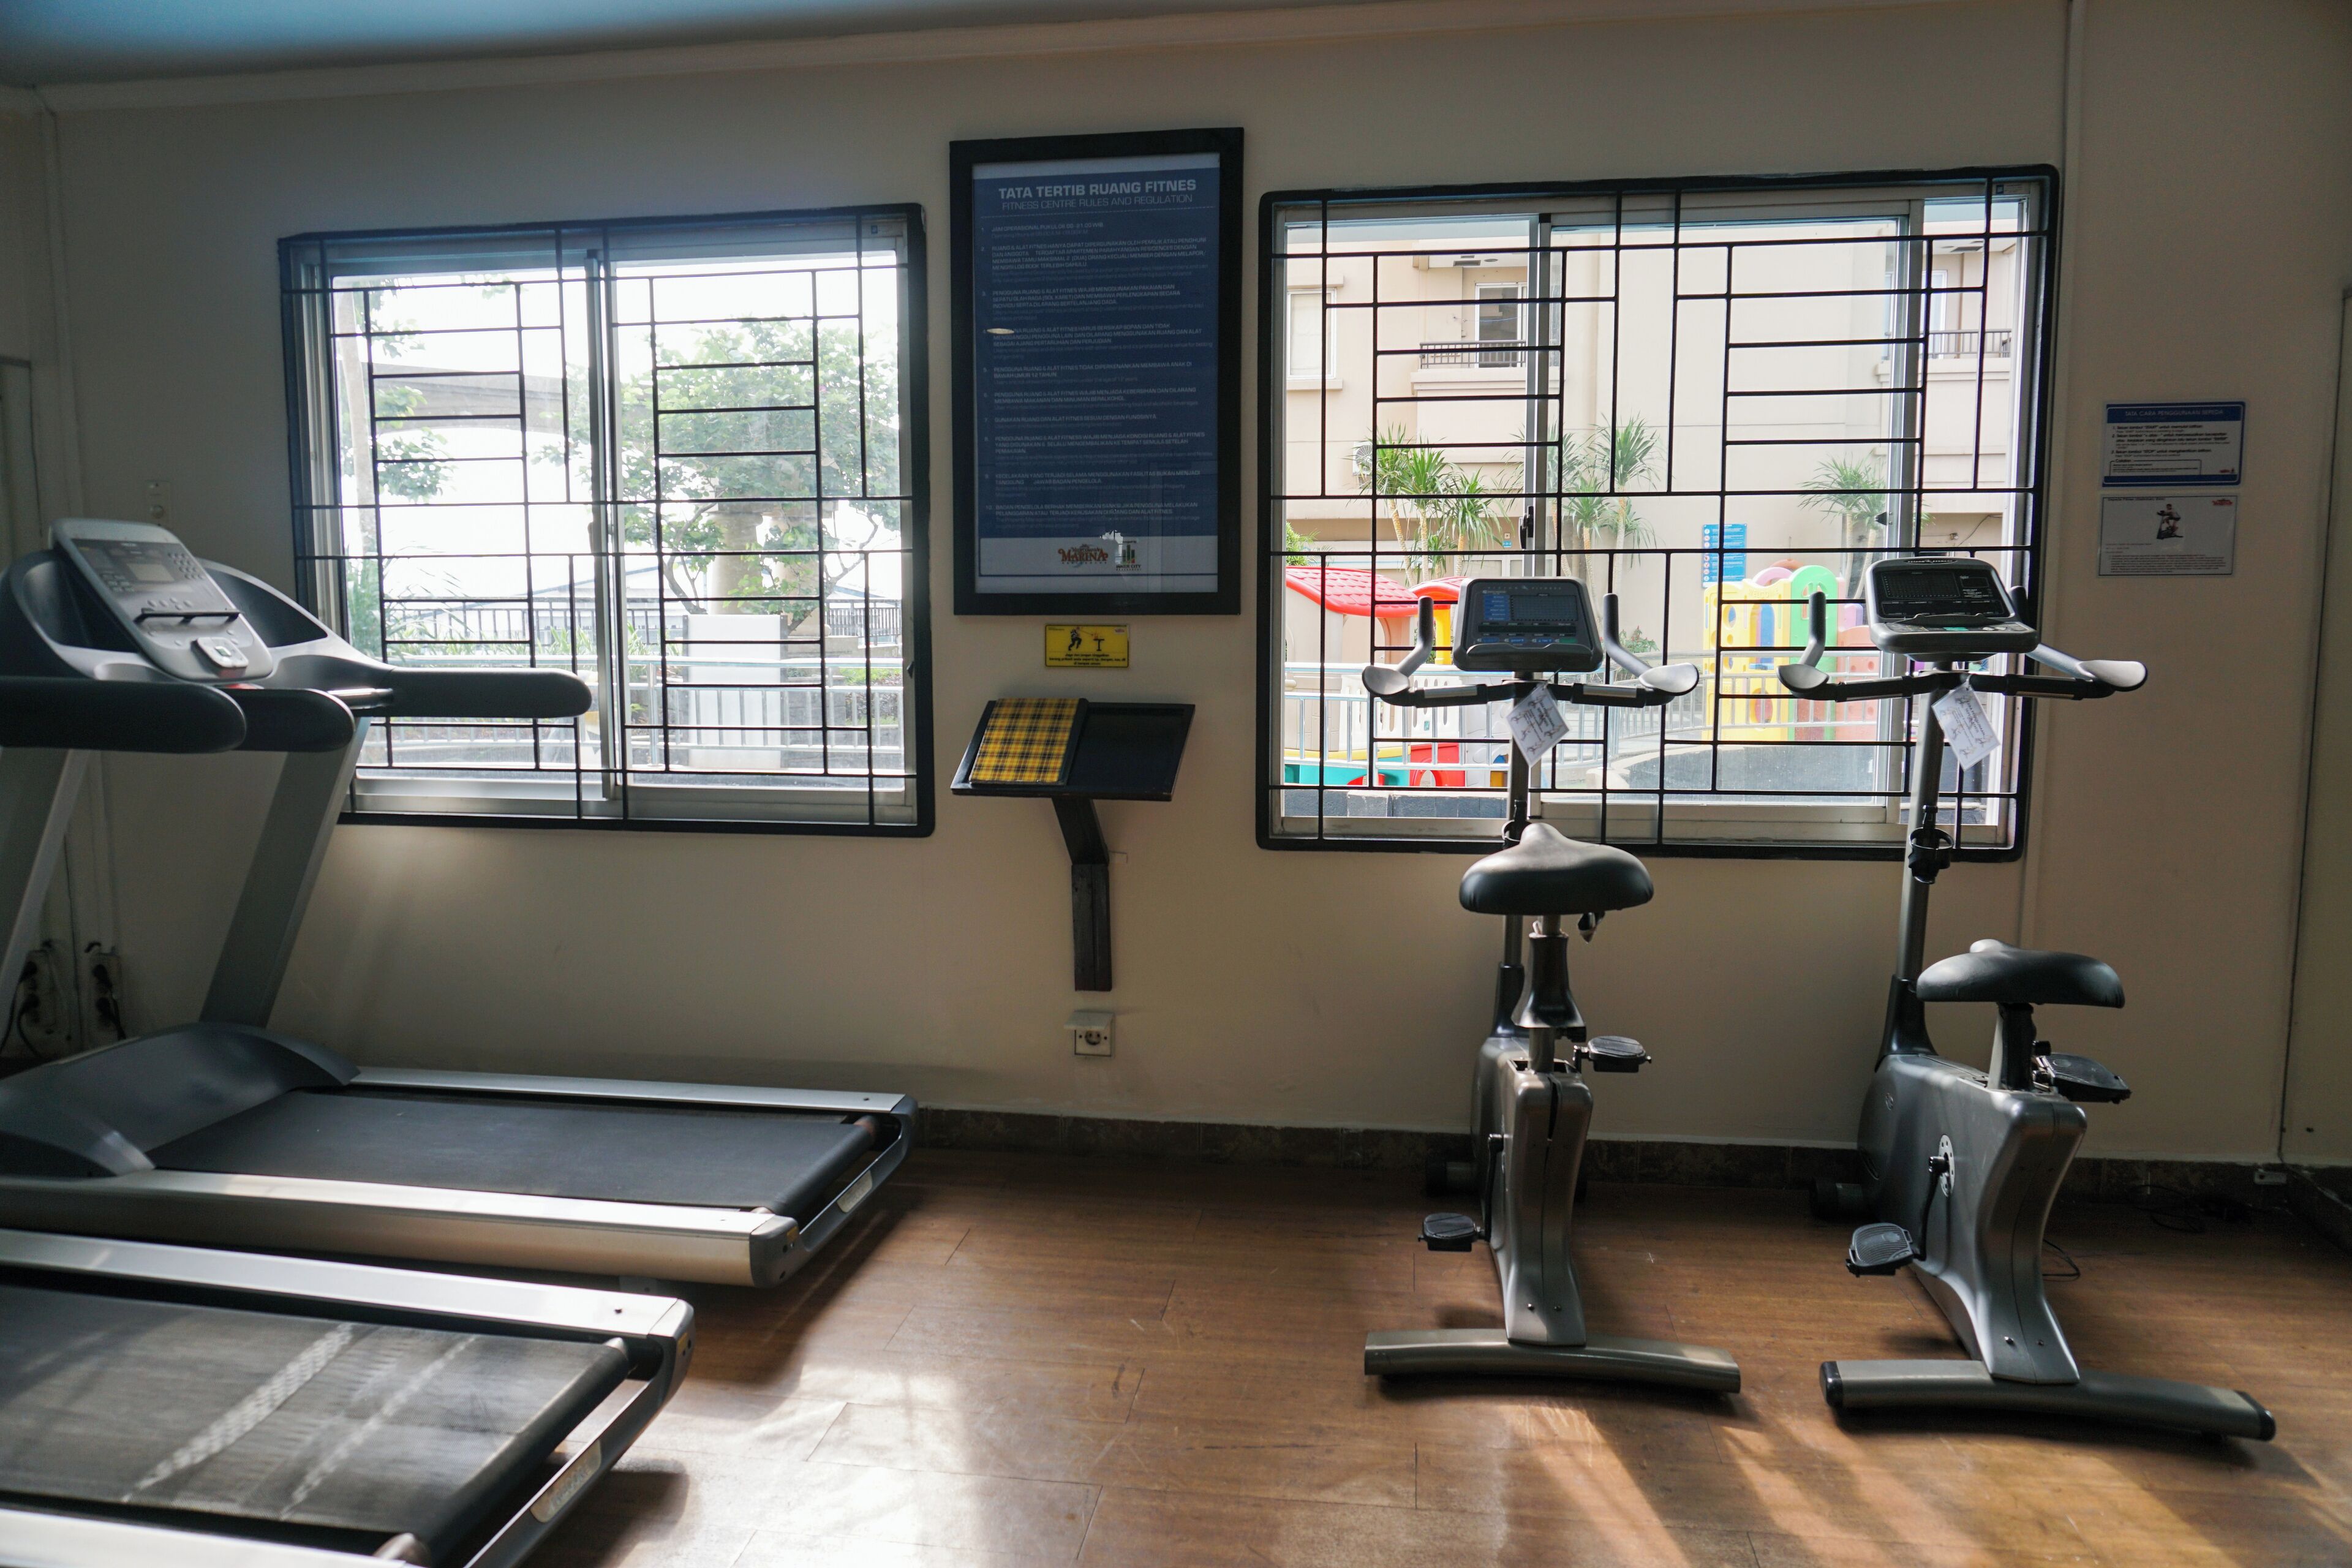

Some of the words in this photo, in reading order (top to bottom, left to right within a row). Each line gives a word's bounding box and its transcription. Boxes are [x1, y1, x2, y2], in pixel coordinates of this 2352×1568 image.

[998, 186, 1033, 198] TATA
[1036, 184, 1086, 197] TERTIB
[1089, 181, 1141, 195] RUANG
[1145, 179, 1196, 192] FITNES
[1002, 200, 1038, 210] FITNESS
[1041, 198, 1077, 209] CENTRE
[1079, 197, 1109, 207] RULES
[1110, 196, 1131, 206] AND
[1133, 193, 1192, 205] REGULATION
[1058, 548, 1108, 561] MARINA
